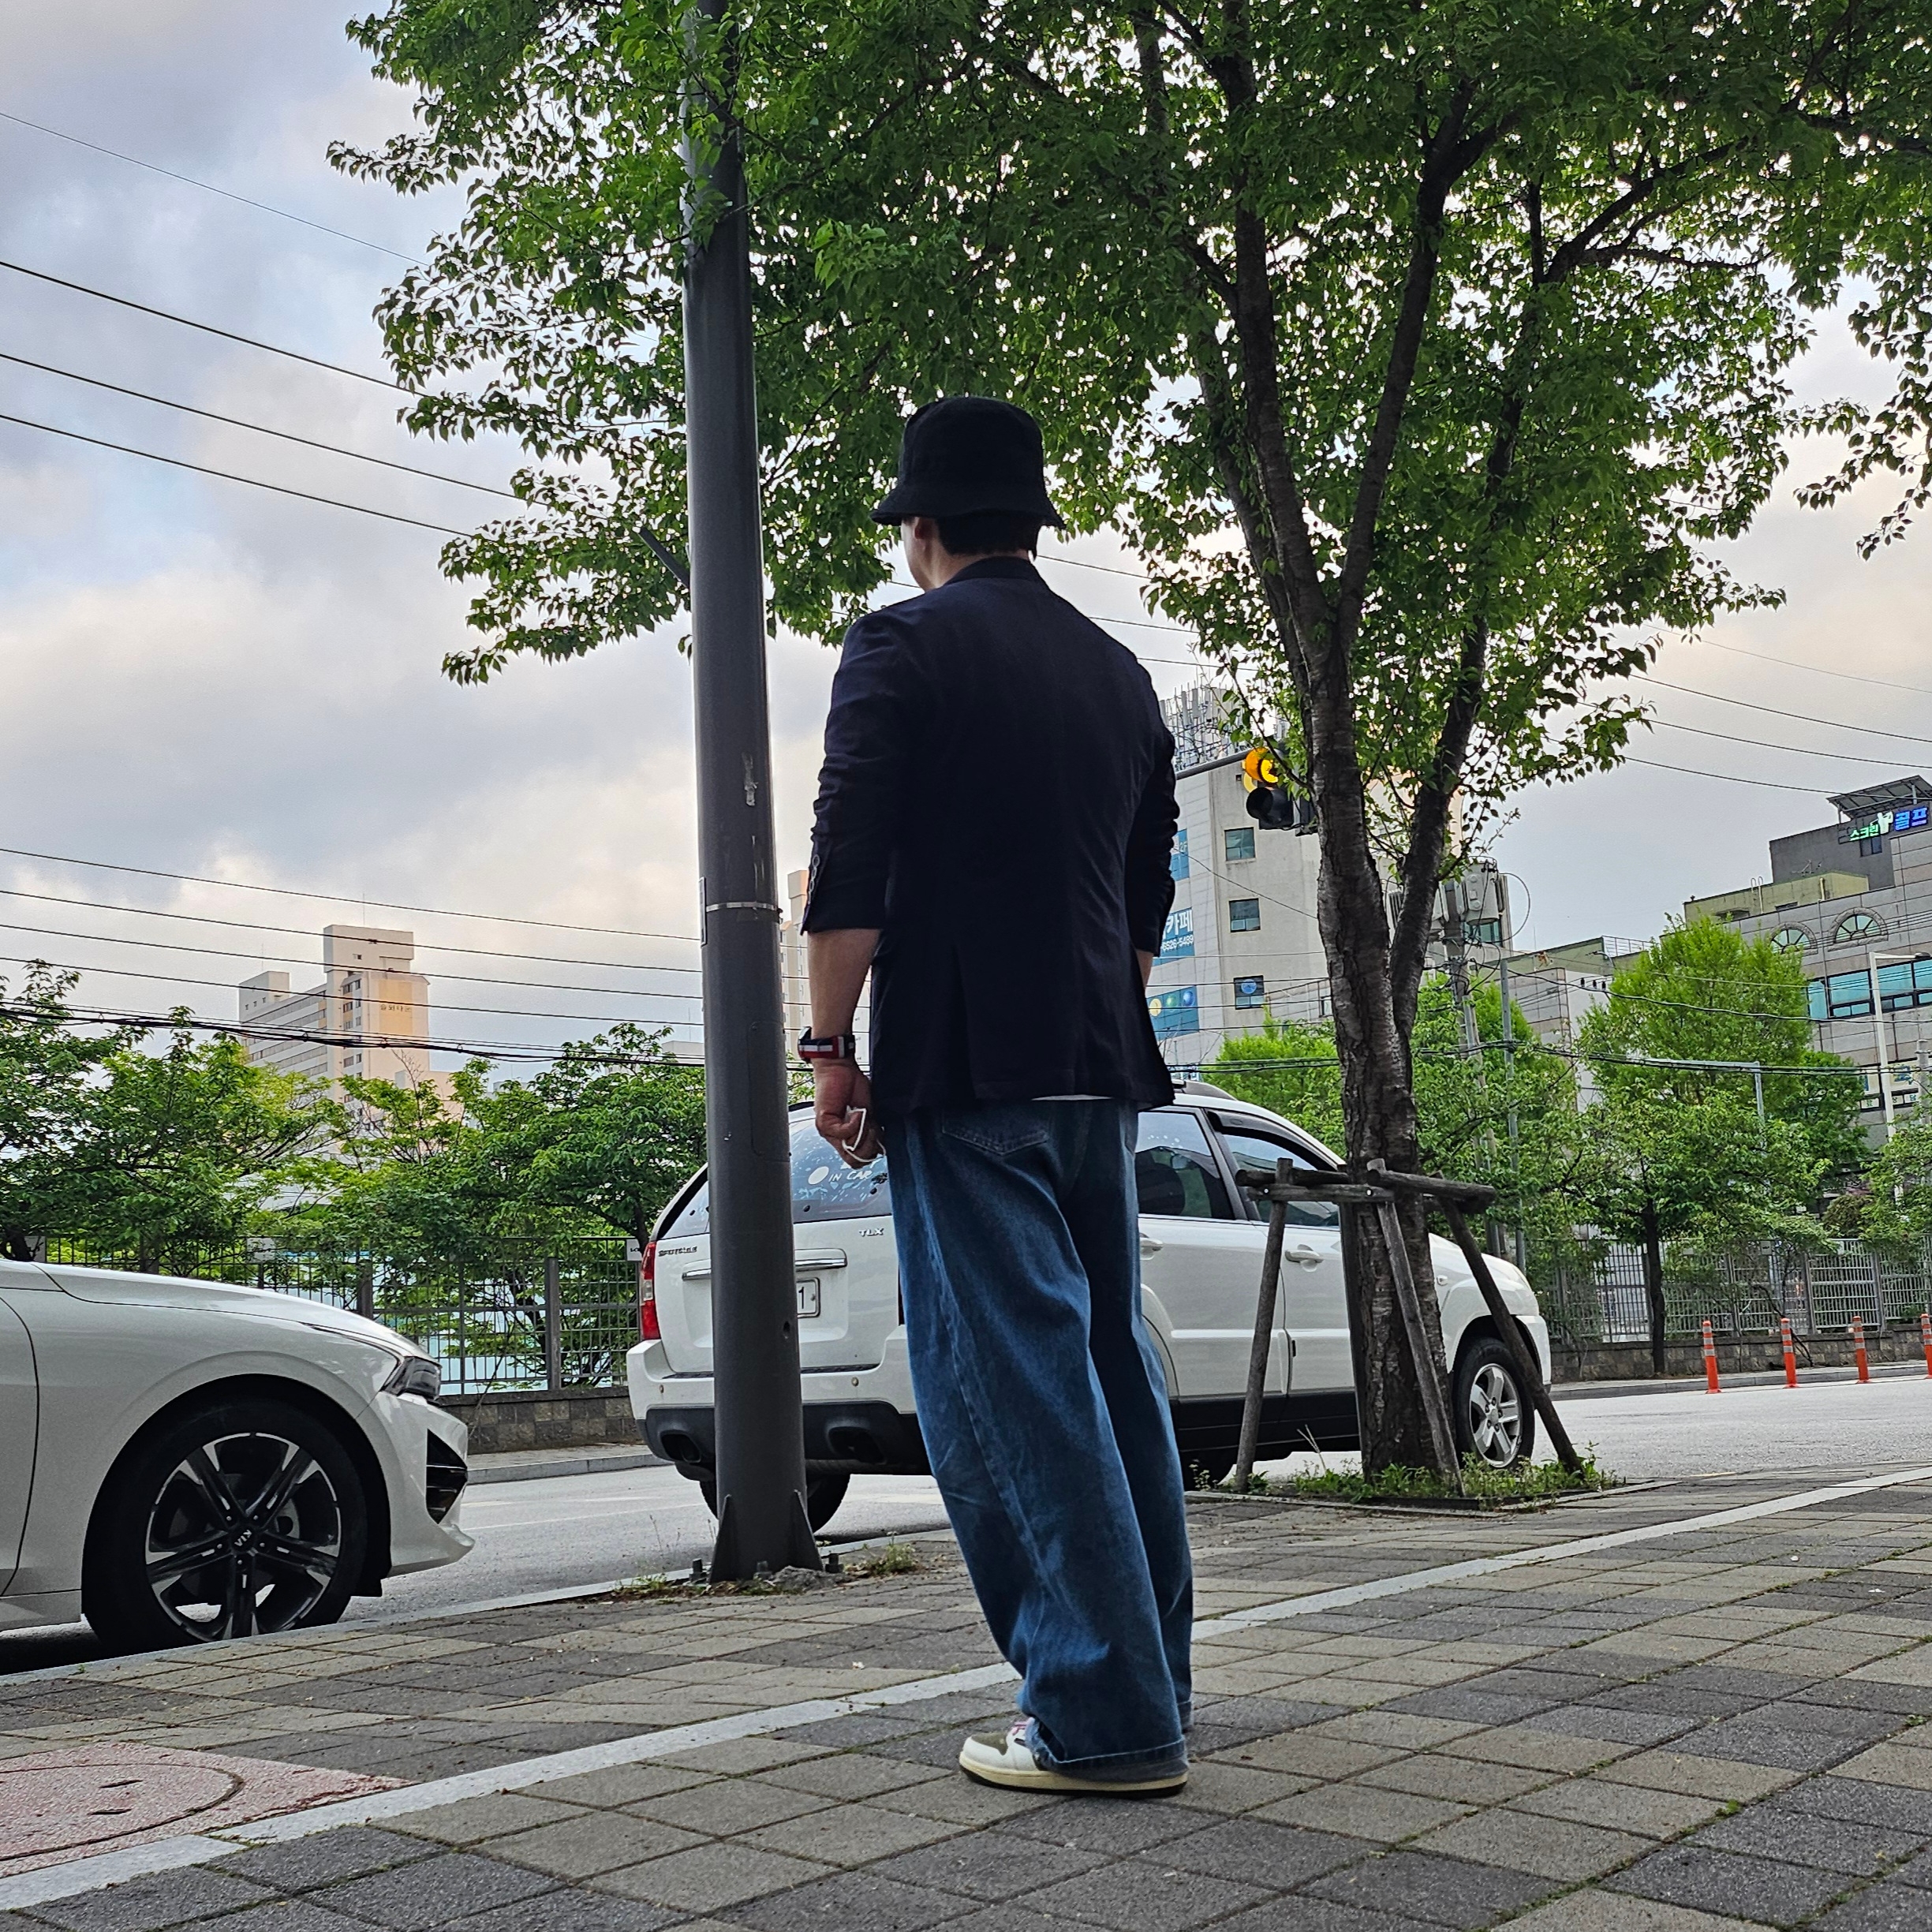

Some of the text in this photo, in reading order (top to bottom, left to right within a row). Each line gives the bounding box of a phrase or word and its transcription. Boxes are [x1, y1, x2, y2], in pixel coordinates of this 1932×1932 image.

[1849, 807, 1927, 841] 스크린 골프
[1163, 909, 1193, 939] 카페
[828, 1170, 873, 1182] IN CAR
[859, 1228, 884, 1237] TLX
[234, 1530, 252, 1546] KIA
